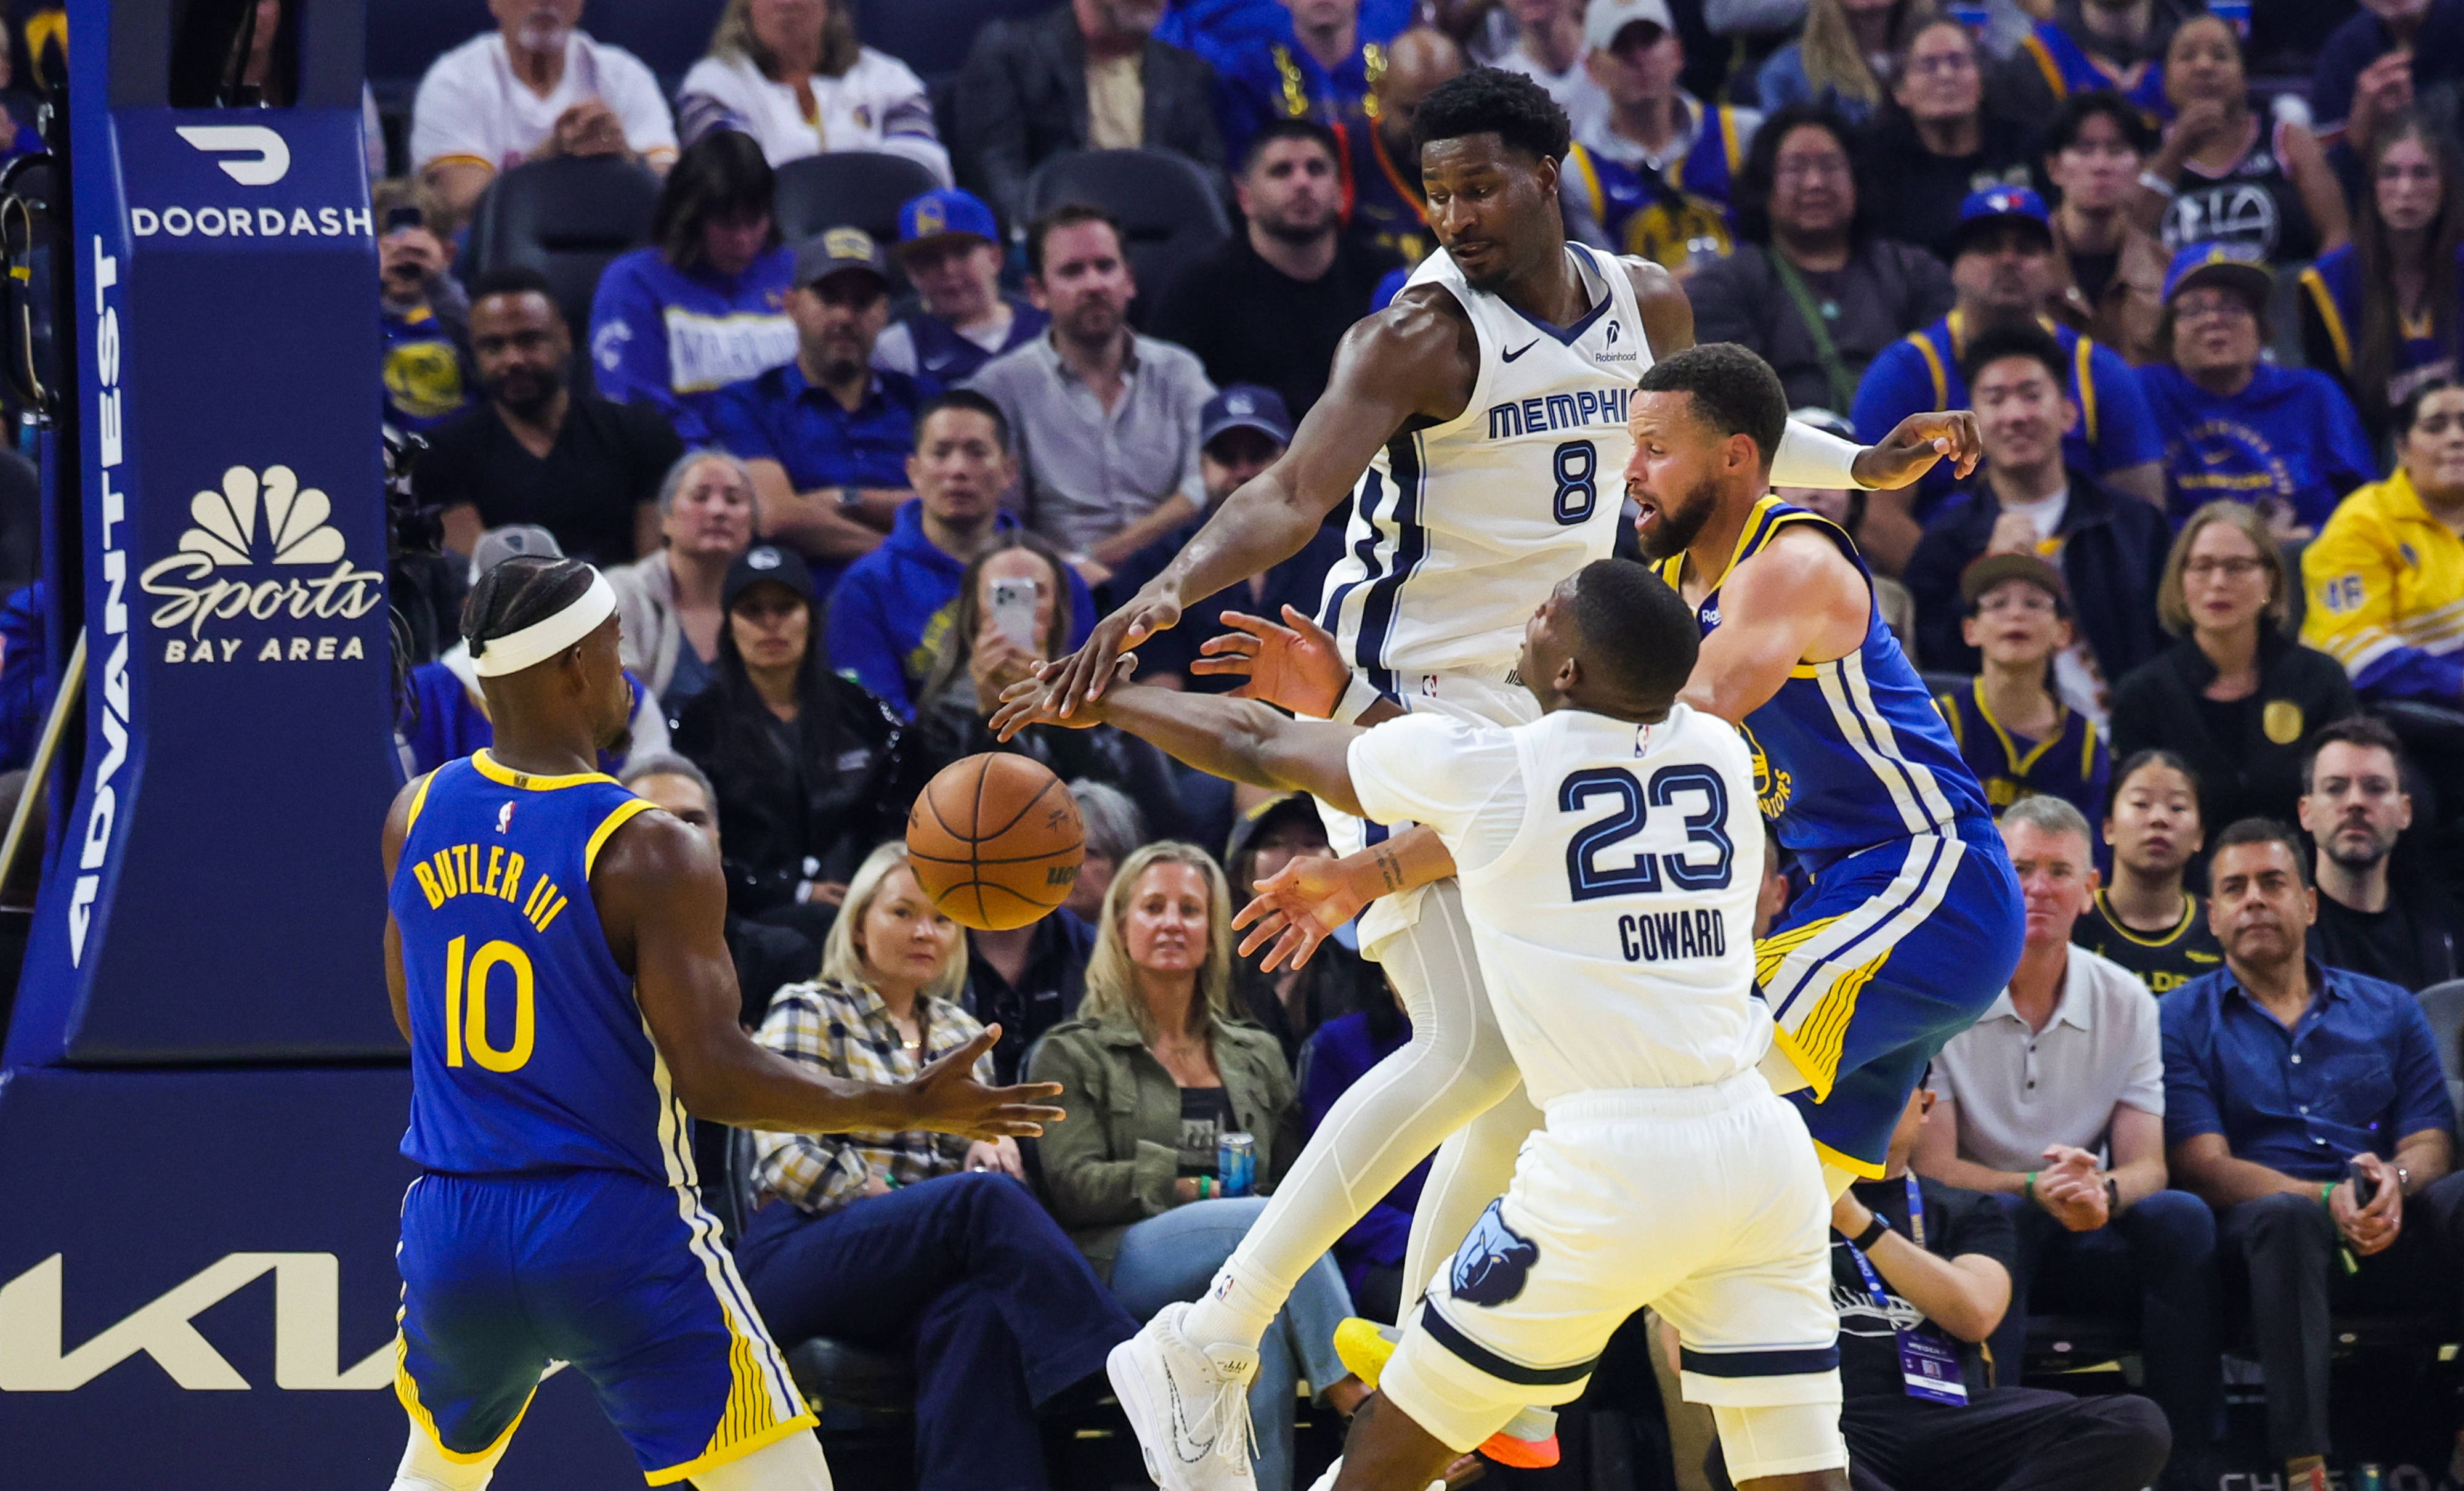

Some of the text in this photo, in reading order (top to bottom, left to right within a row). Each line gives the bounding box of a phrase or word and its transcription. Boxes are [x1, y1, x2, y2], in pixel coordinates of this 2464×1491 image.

[132, 208, 373, 237] DOORDASH
[1595, 350, 1637, 362] Robinhood
[1489, 389, 1638, 439] MEMPHI
[1553, 439, 1597, 526] 8
[68, 234, 129, 969] ADVANTEST
[140, 559, 384, 642] Sports
[164, 636, 364, 664] BAY AREA
[1558, 763, 1734, 902] 23
[412, 843, 568, 933] BUTLER III
[1618, 909, 1725, 962] COWARD
[446, 934, 535, 1073] 10
